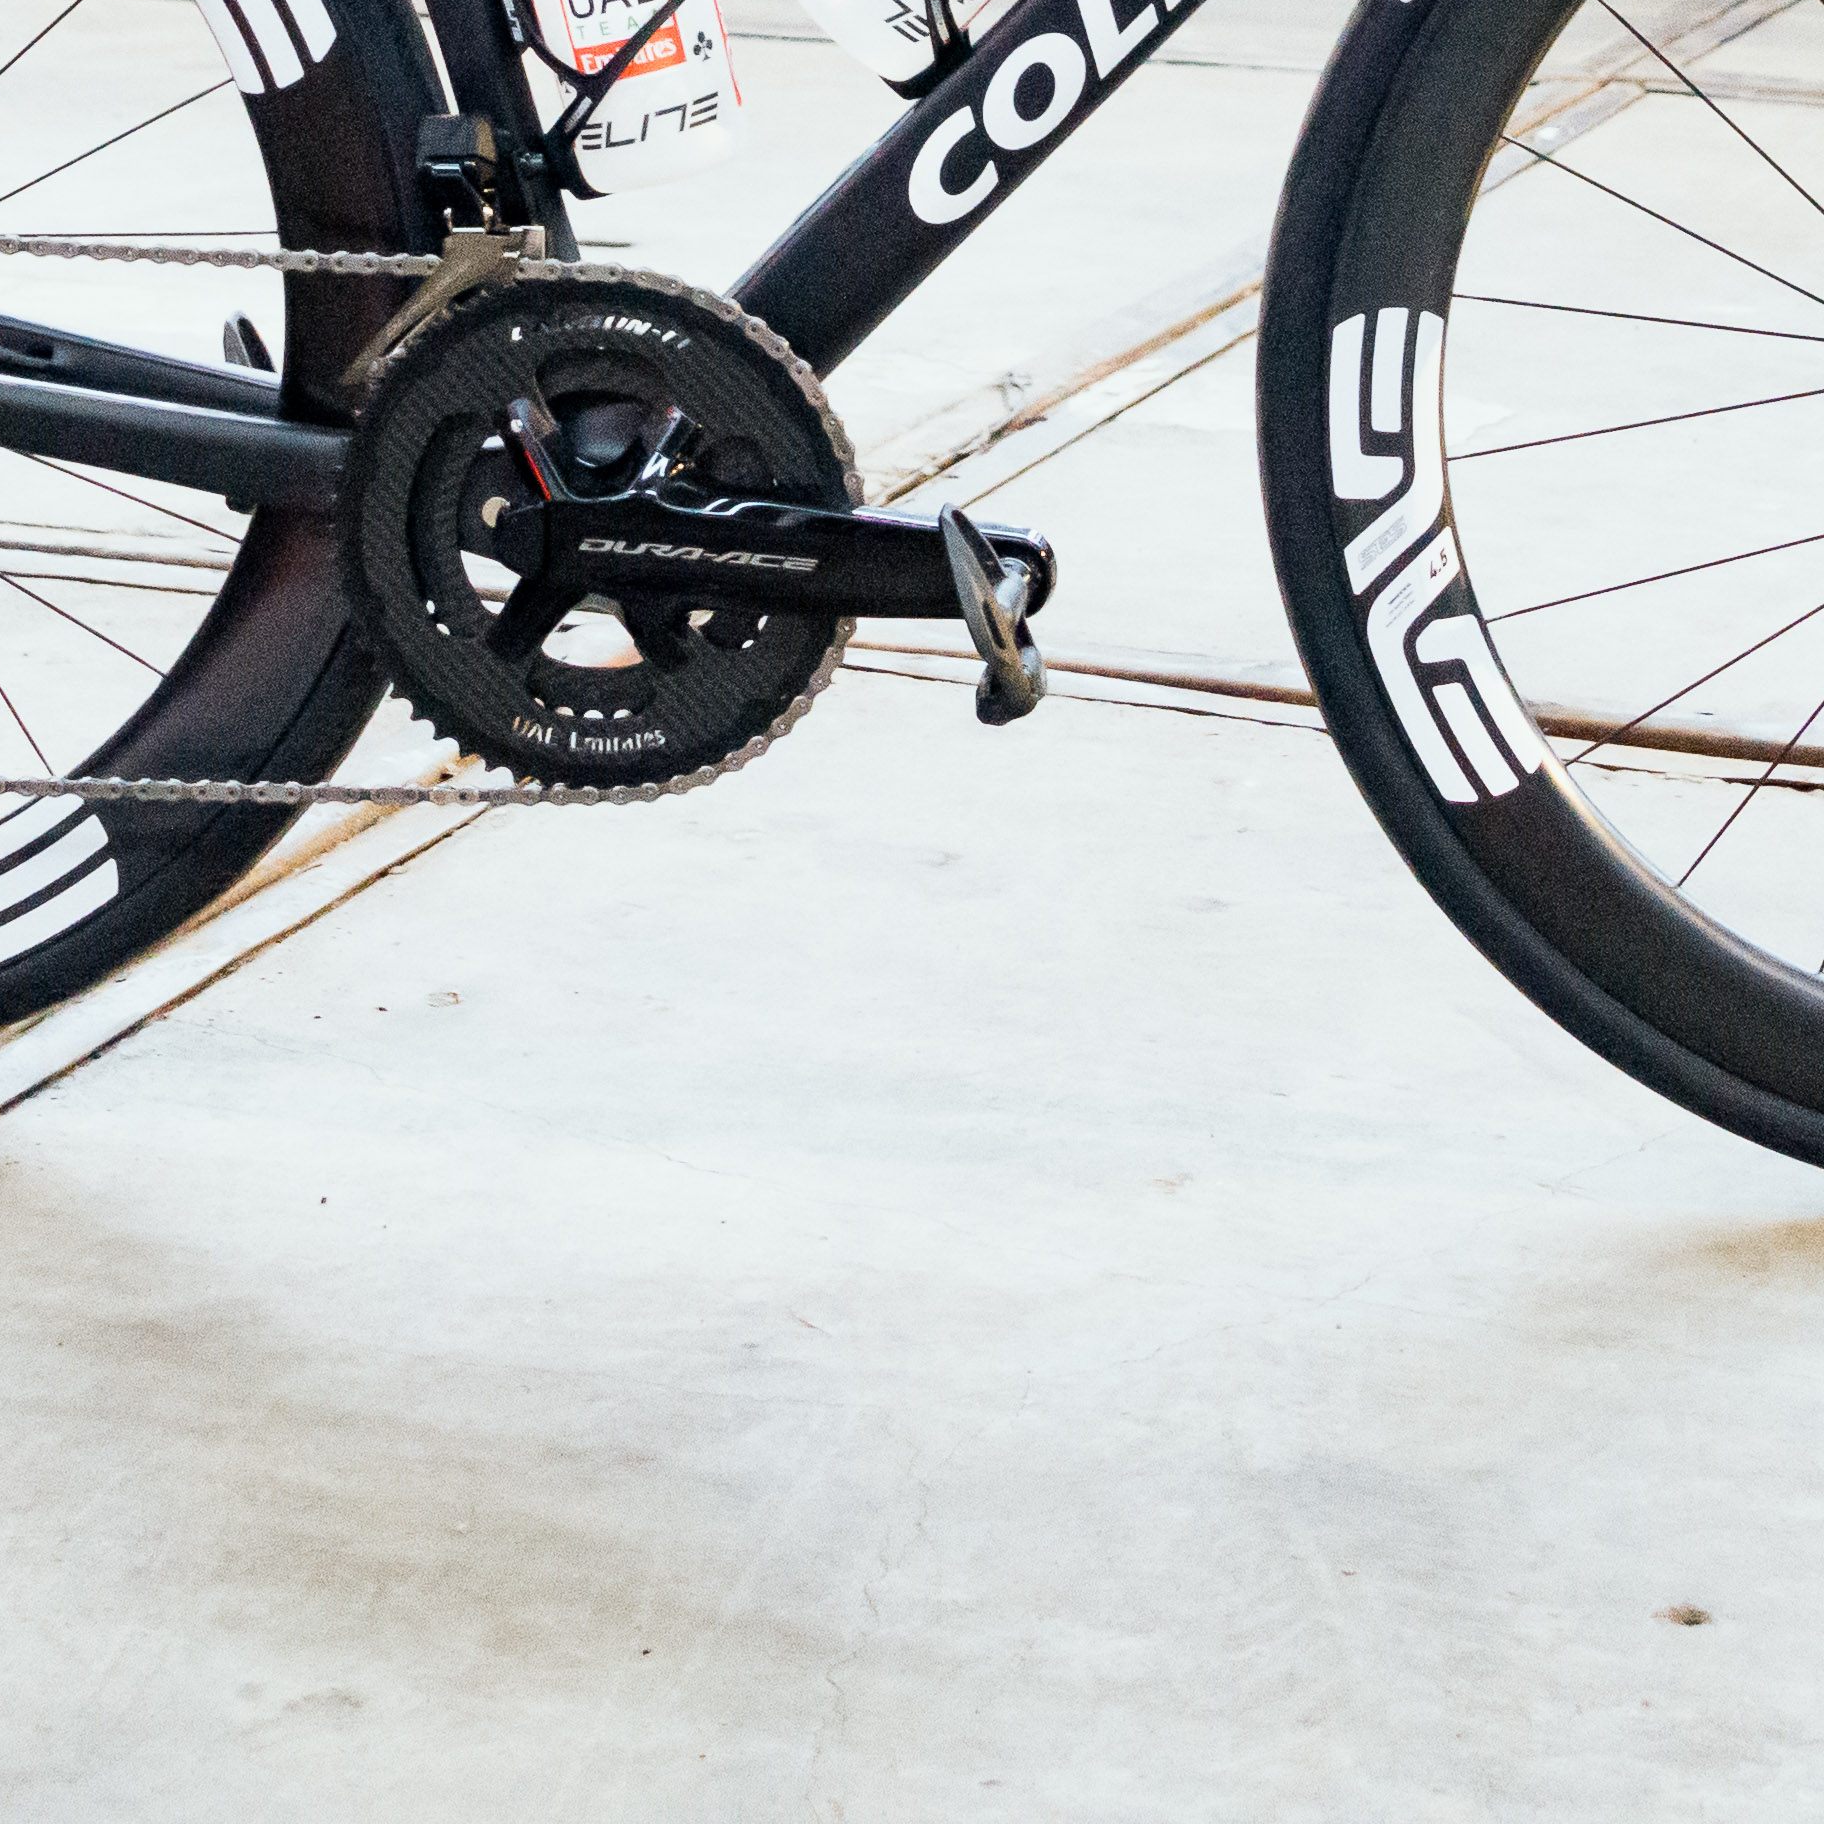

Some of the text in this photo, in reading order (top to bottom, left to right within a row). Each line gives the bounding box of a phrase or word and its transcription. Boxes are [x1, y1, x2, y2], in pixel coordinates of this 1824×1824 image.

[579, 90, 720, 152] ELITE
[578, 538, 819, 572] DURA-ACE
[1429, 546, 1448, 580] 4.5
